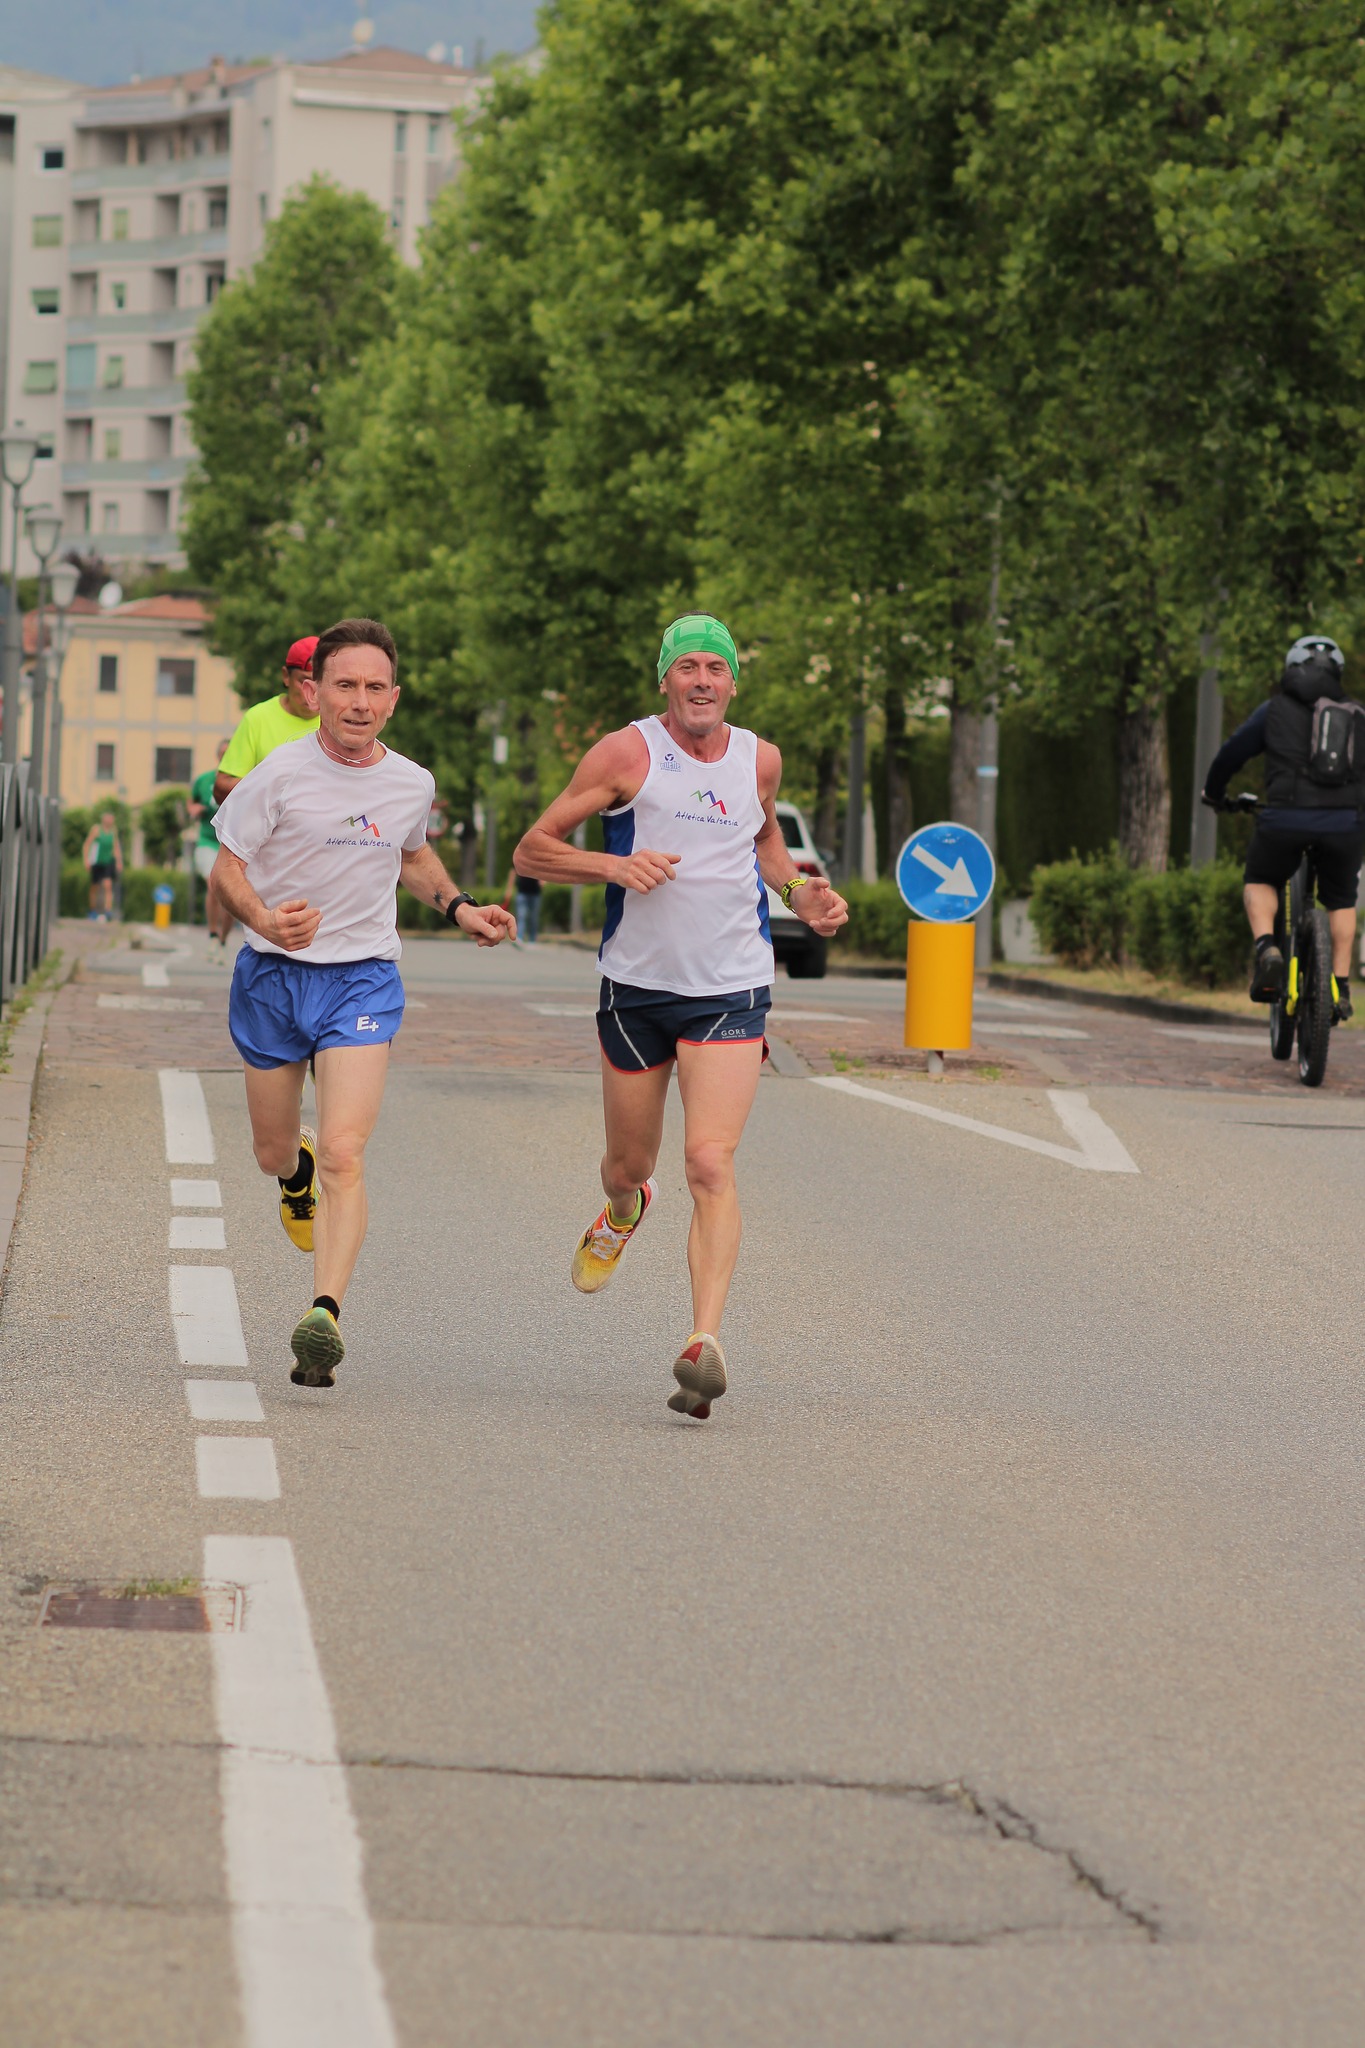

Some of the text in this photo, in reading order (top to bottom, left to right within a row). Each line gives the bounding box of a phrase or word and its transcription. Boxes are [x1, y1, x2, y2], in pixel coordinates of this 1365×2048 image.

[675, 811, 739, 827] Atletica Valsesia
[325, 838, 391, 847] Atletica Valsesia
[721, 1028, 746, 1036] GORE
